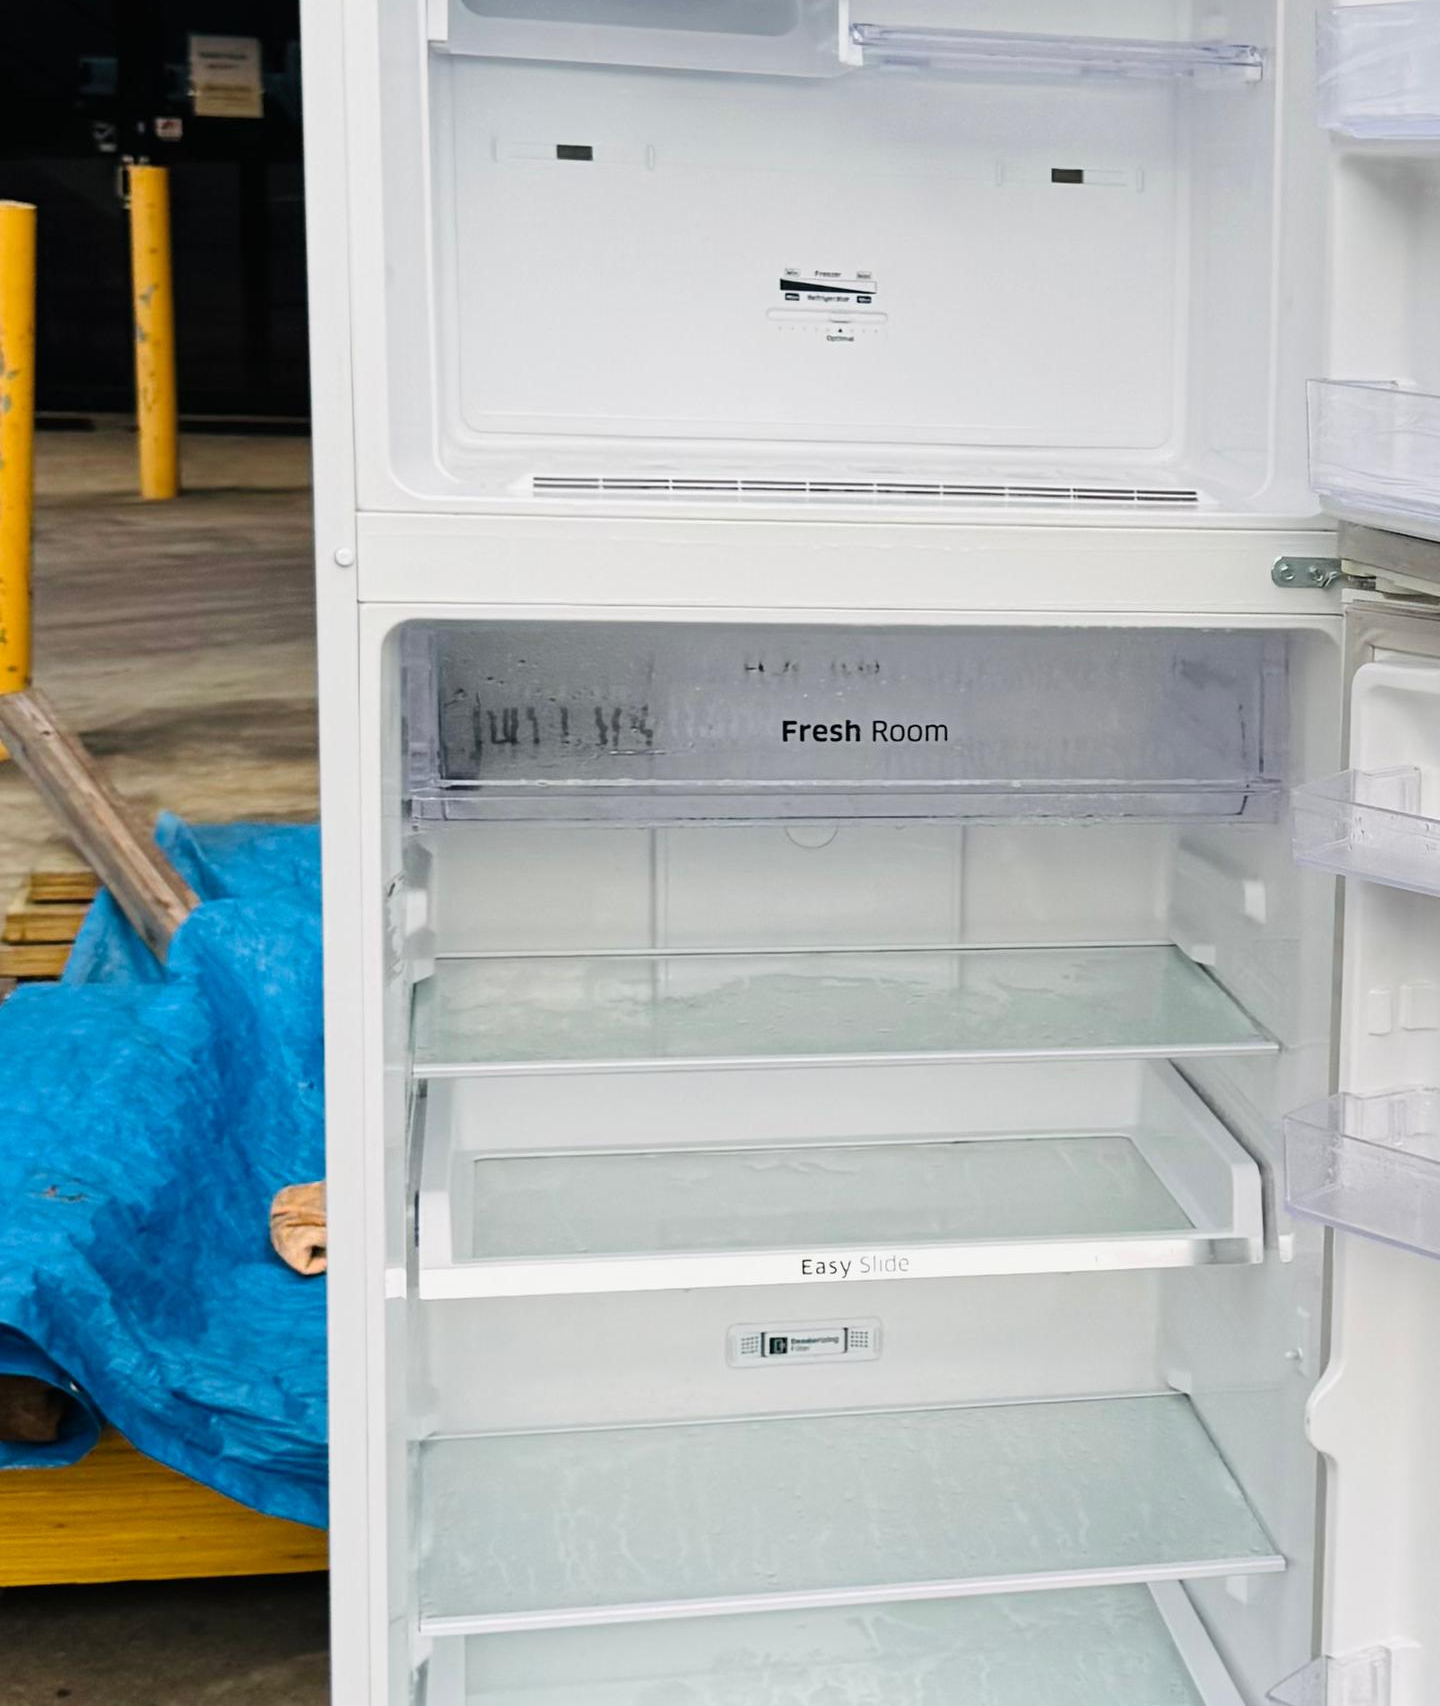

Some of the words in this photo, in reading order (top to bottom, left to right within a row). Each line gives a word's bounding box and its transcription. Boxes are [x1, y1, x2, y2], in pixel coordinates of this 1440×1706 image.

[782, 720, 861, 742] Fresh
[872, 720, 948, 742] Room
[802, 1259, 851, 1278] Easy
[860, 1255, 909, 1273] Slide
